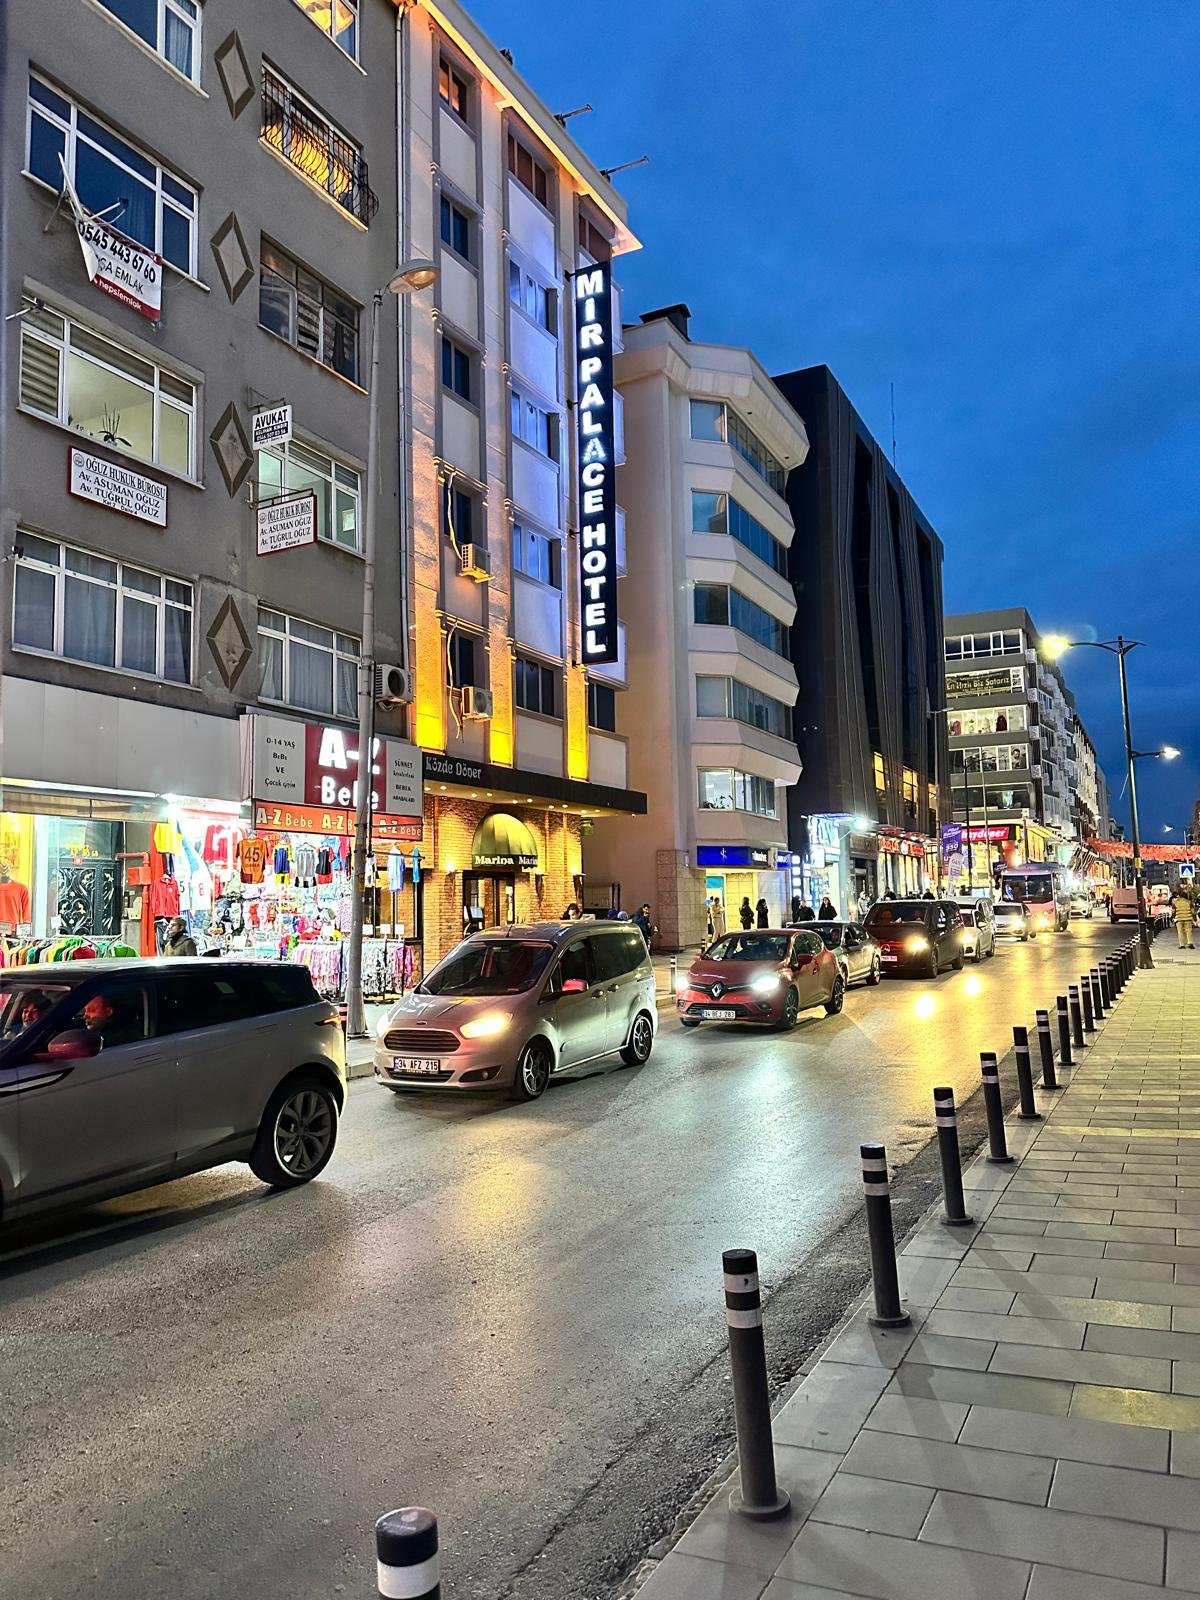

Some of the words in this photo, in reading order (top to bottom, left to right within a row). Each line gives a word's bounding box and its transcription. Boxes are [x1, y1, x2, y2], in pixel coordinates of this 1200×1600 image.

[78, 221, 108, 249] 0545
[110, 241, 131, 263] 443
[132, 254, 144, 272] 67
[144, 264, 156, 283] 60
[95, 254, 113, 274] ŞA
[115, 266, 144, 294] EMLAK
[99, 279, 142, 311] hepsiemlak
[255, 409, 287, 429] AVUKAT
[580, 356, 607, 514] PALACE
[86, 458, 108, 476] OĞUZ
[109, 467, 136, 488] HUKUK
[137, 478, 165, 499] BÜROSU
[79, 471, 92, 482] Av.
[94, 477, 134, 499] ASUMAN
[136, 492, 160, 508] OĞUZ
[80, 483, 93, 494] Av.
[95, 488, 132, 508] TUĞRUL
[134, 502, 159, 518] OĞUZ
[268, 508, 280, 522] OĞUZ
[269, 521, 294, 533] ASUMAN
[294, 516, 311, 527] OĞUZ
[269, 532, 293, 544] TUĞRUL
[293, 527, 311, 538] OĞUZ
[582, 522, 607, 654] HOTEL
[266, 737, 282, 746] 0-14
[284, 740, 296, 749] YAŞ
[394, 759, 413, 770] SÜNNET
[425, 757, 453, 774] Közde
[455, 762, 482, 779] Döner
[256, 807, 282, 825] A-Z
[285, 812, 313, 829] Bebe
[321, 812, 344, 832] A-Z
[378, 819, 398, 834] A-Z
[245, 847, 260, 862] 45
[475, 855, 514, 865] Marina
[399, 1059, 407, 1069] 34
[411, 1060, 422, 1070] AFZ
[425, 1060, 438, 1071] 215
